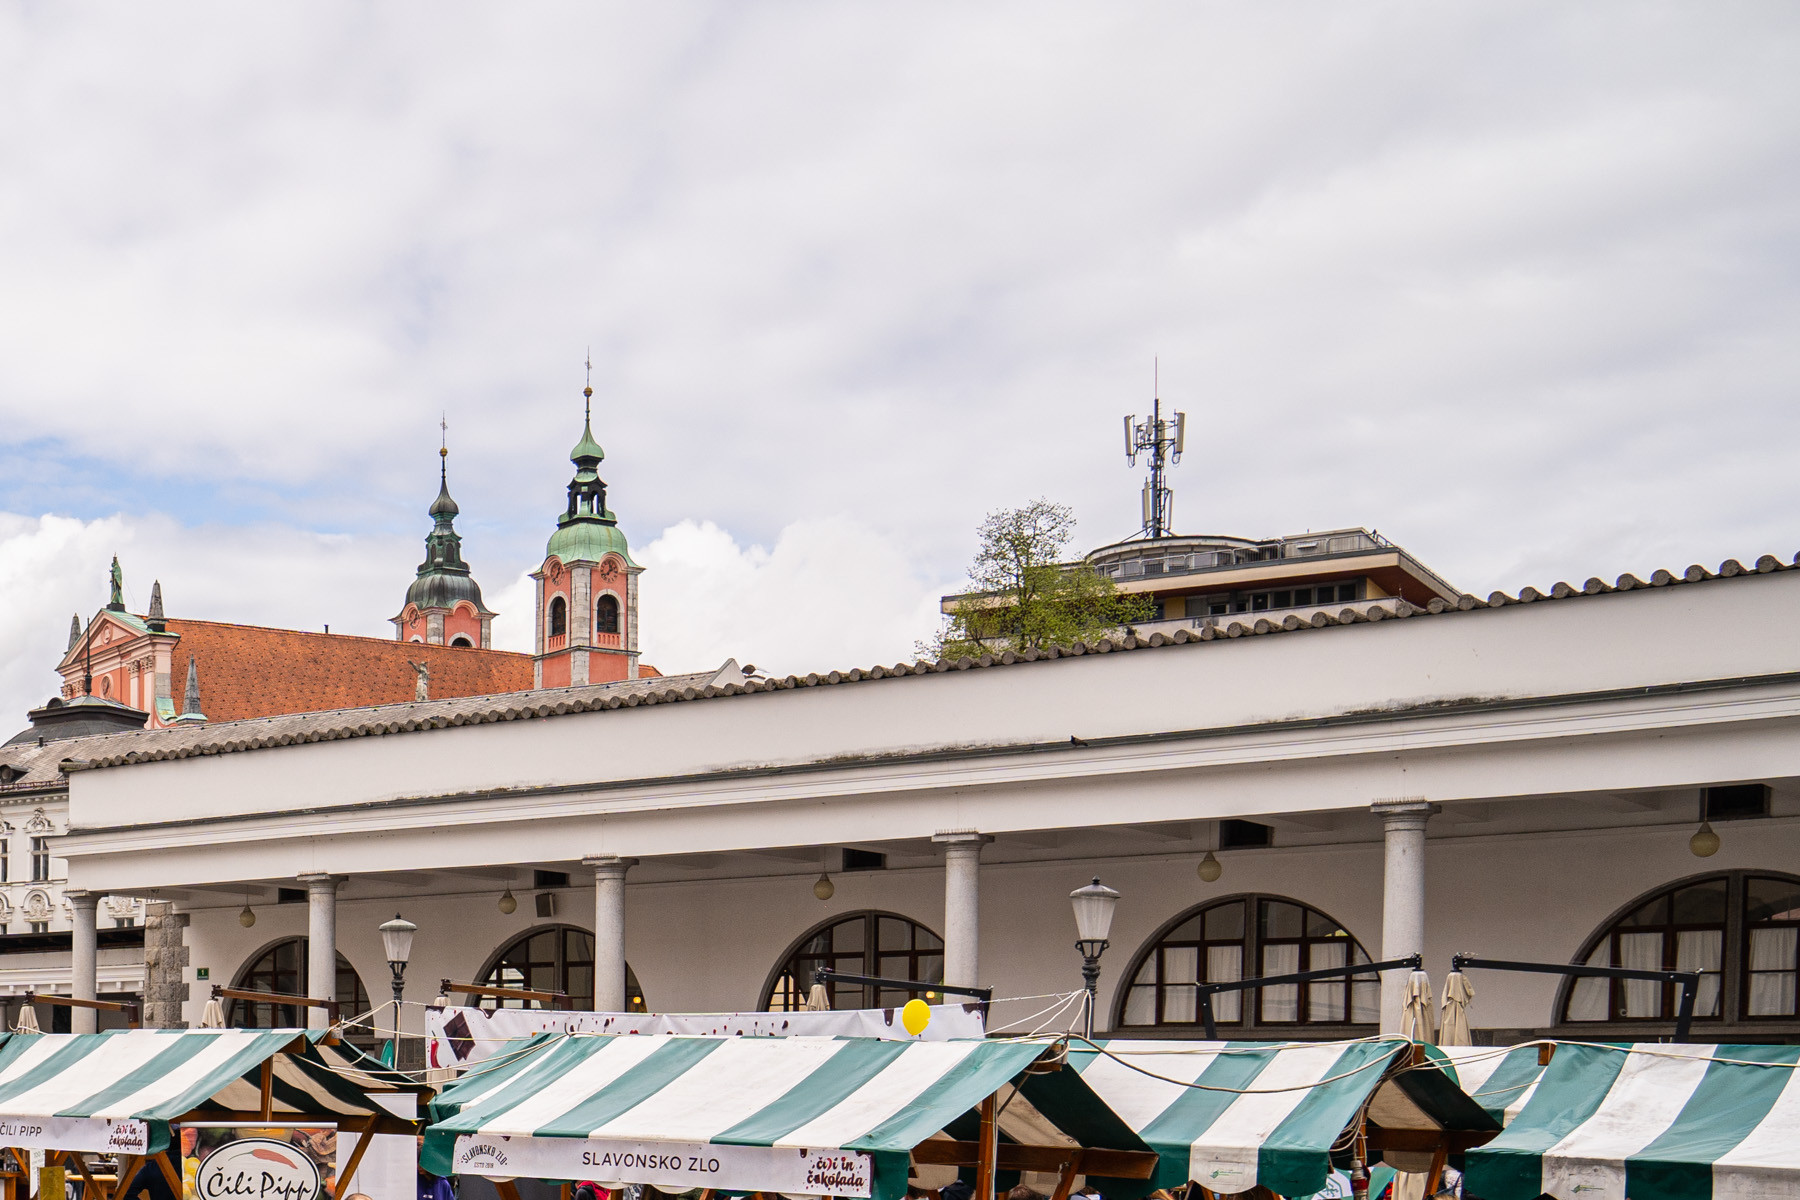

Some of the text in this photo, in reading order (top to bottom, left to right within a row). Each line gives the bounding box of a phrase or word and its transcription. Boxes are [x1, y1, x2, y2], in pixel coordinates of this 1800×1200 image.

[0, 1122, 42, 1137] ČILI PIPP
[462, 1144, 508, 1165] SLAVONSKO ZLO
[582, 1151, 720, 1173] SLAVONSKO ZLO
[207, 1167, 255, 1197] Čili
